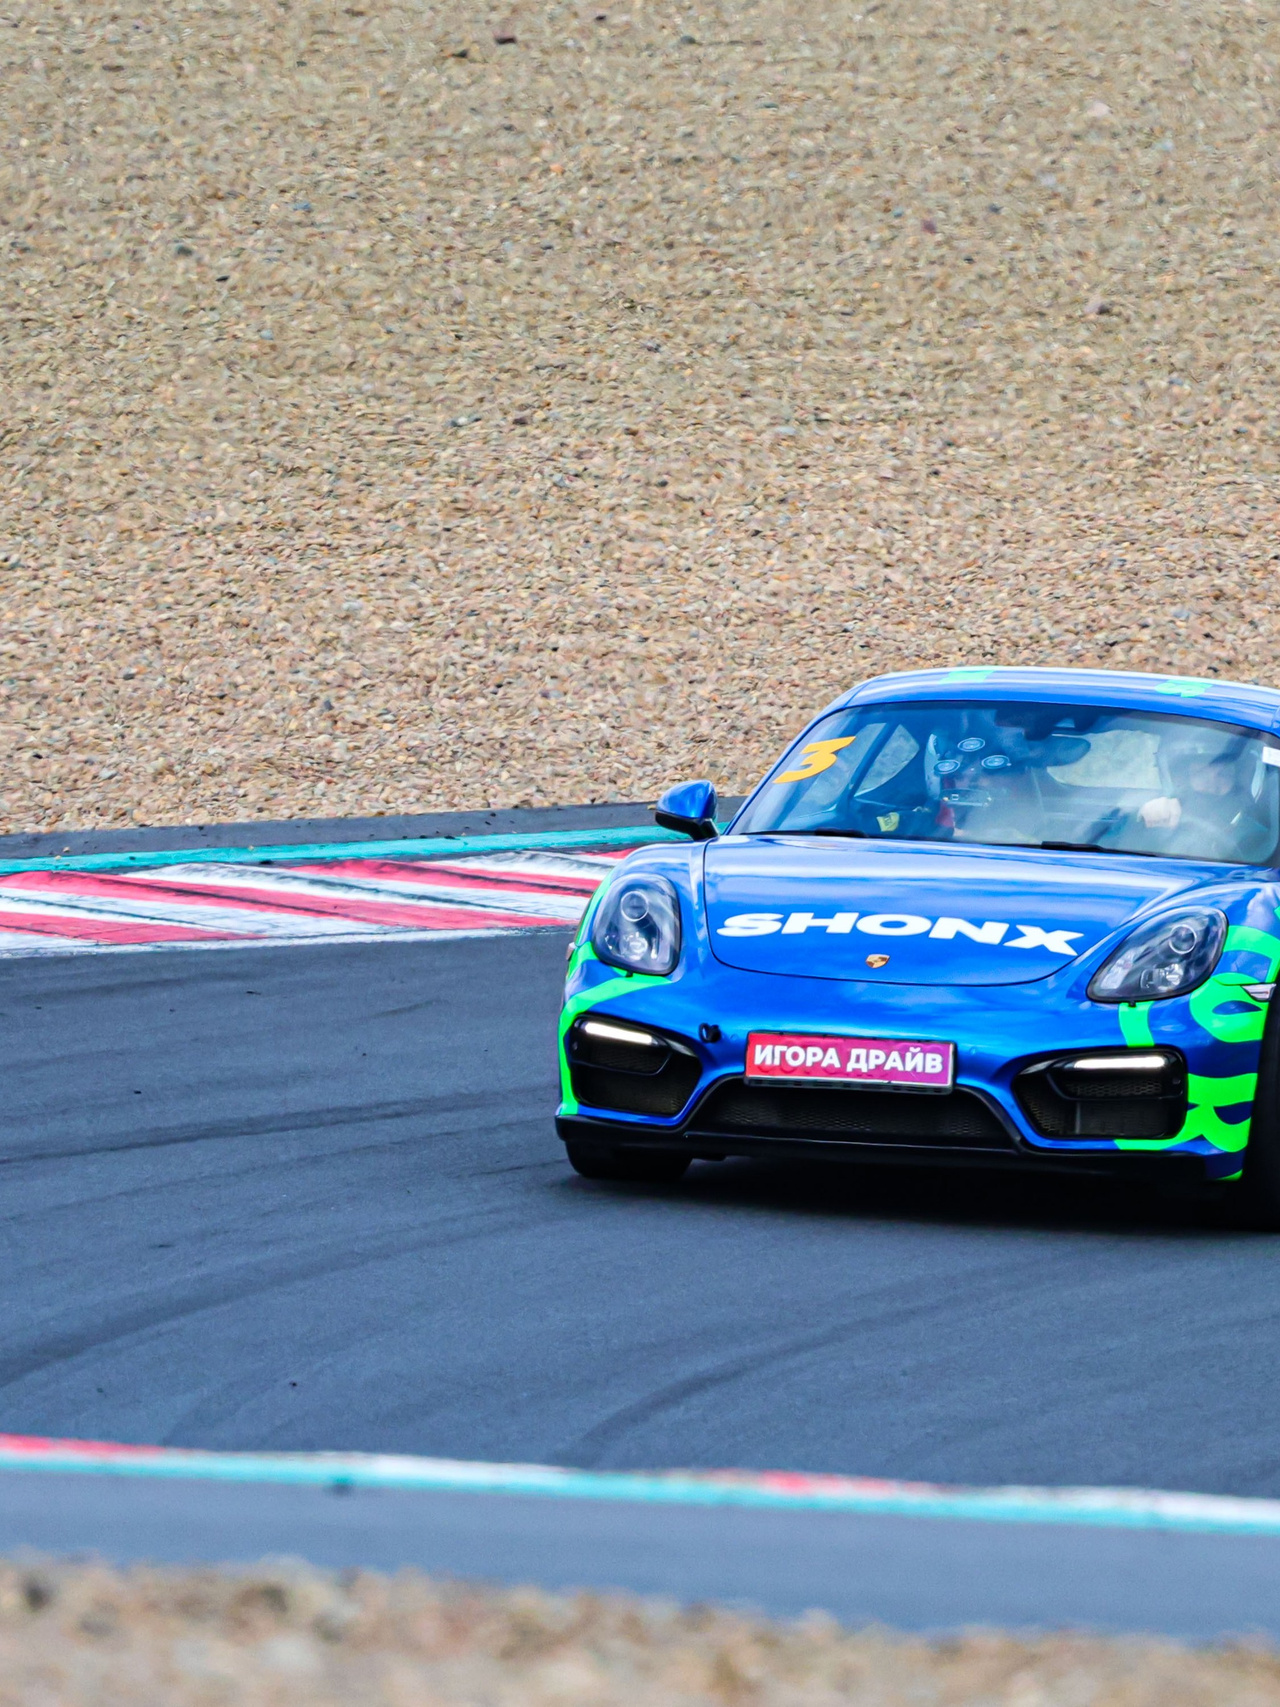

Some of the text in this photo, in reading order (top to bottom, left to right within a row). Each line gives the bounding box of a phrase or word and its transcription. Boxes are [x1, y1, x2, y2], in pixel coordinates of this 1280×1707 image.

[772, 735, 857, 784] 3
[716, 912, 1085, 956] SHONX
[754, 1044, 944, 1074] ИГОРА ДРАЙВ
